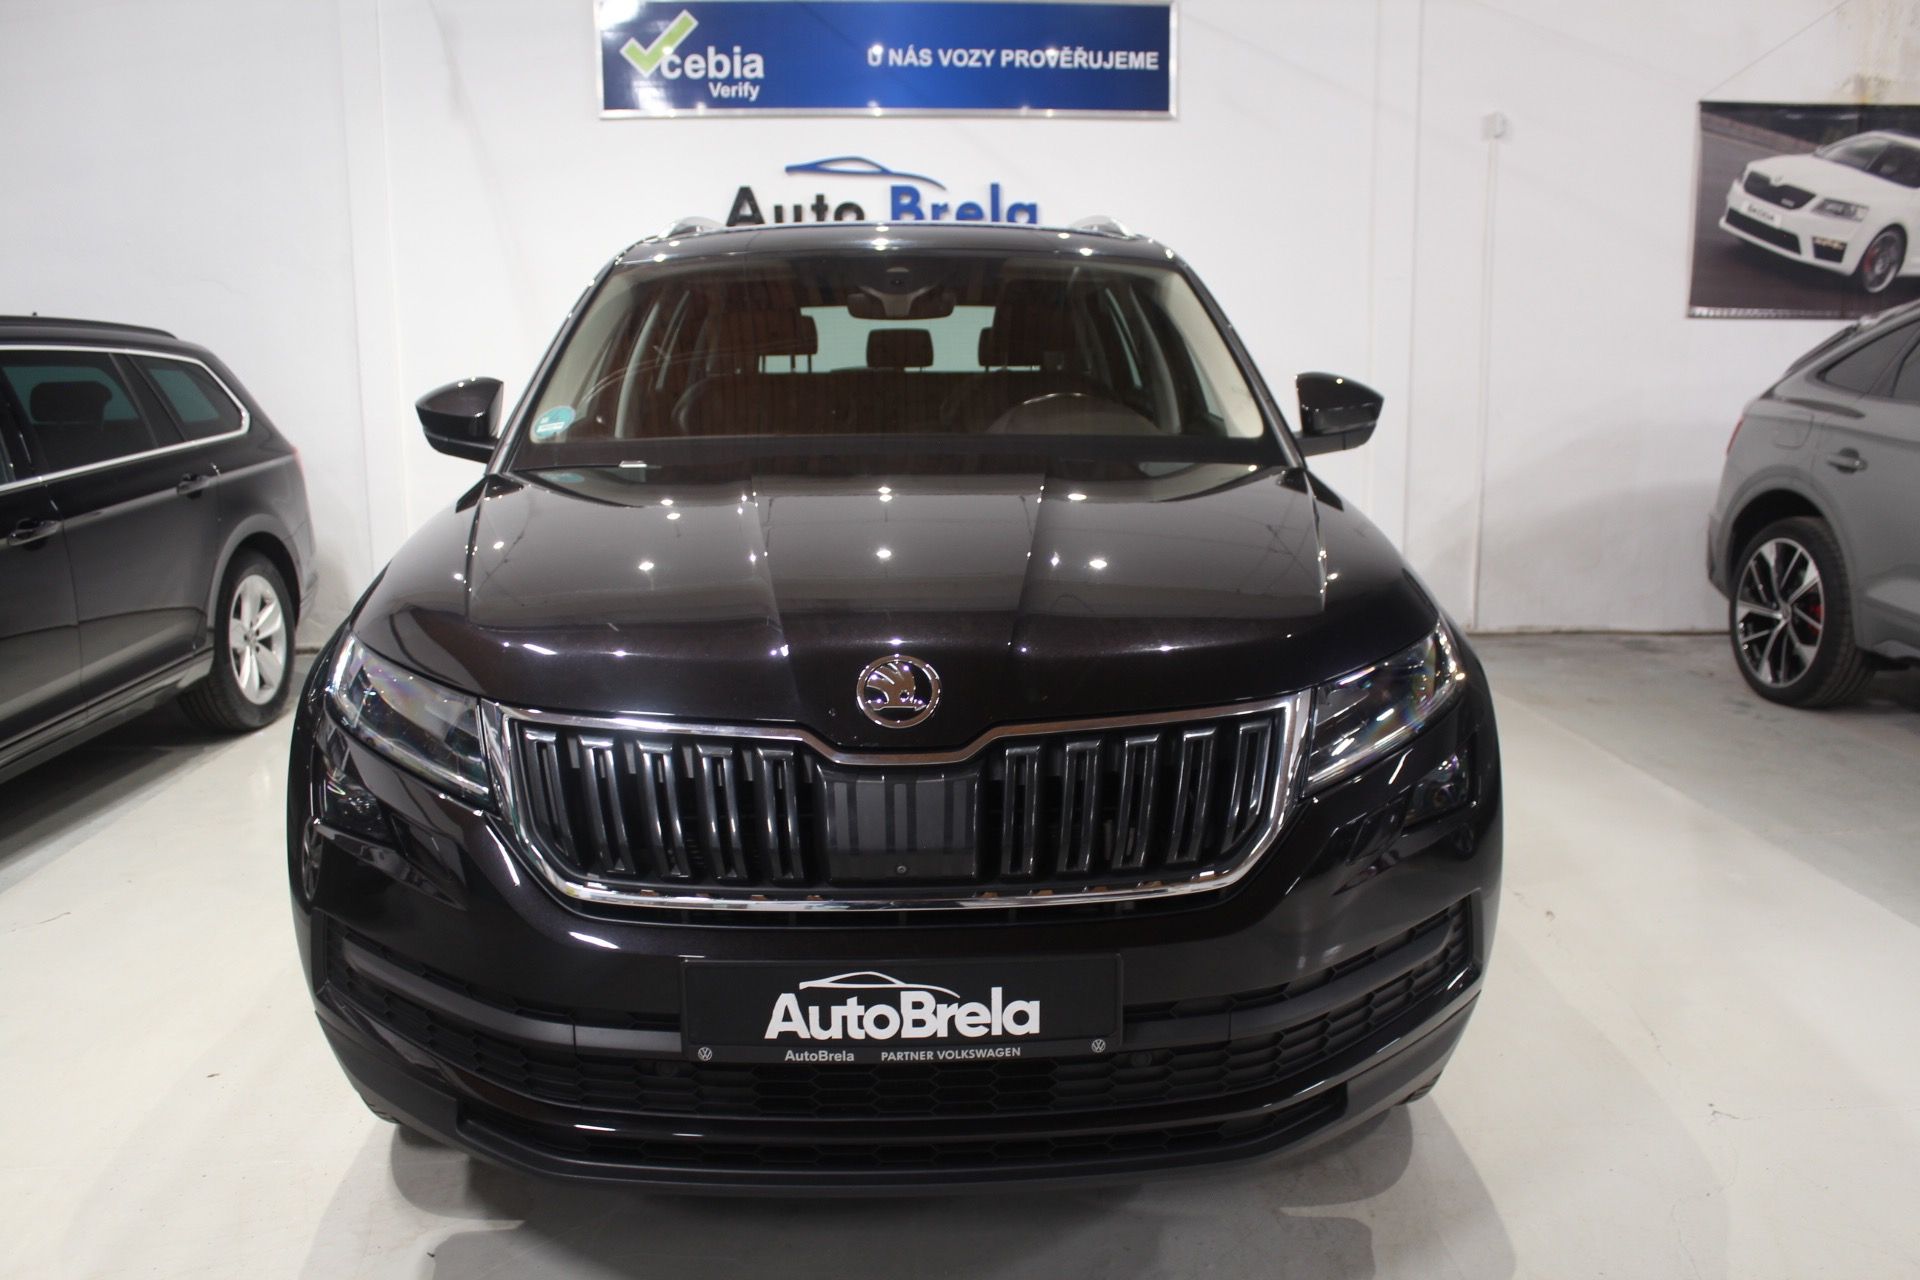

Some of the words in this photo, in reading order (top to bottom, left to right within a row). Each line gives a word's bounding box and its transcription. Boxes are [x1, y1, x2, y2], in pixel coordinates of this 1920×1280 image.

[660, 45, 765, 80] cebia
[888, 44, 934, 67] NÁS
[938, 48, 996, 68] VOZY
[1001, 46, 1160, 70] PROVĚŘUJEME
[708, 81, 761, 102] Verify
[726, 185, 866, 227] Auto
[890, 183, 1038, 225] Brela
[764, 986, 1041, 1041] AutoBrela
[784, 1049, 855, 1063] AutoBrela
[881, 1050, 935, 1062] PARTNER
[937, 1046, 1021, 1061] VOLKSWAGEN
